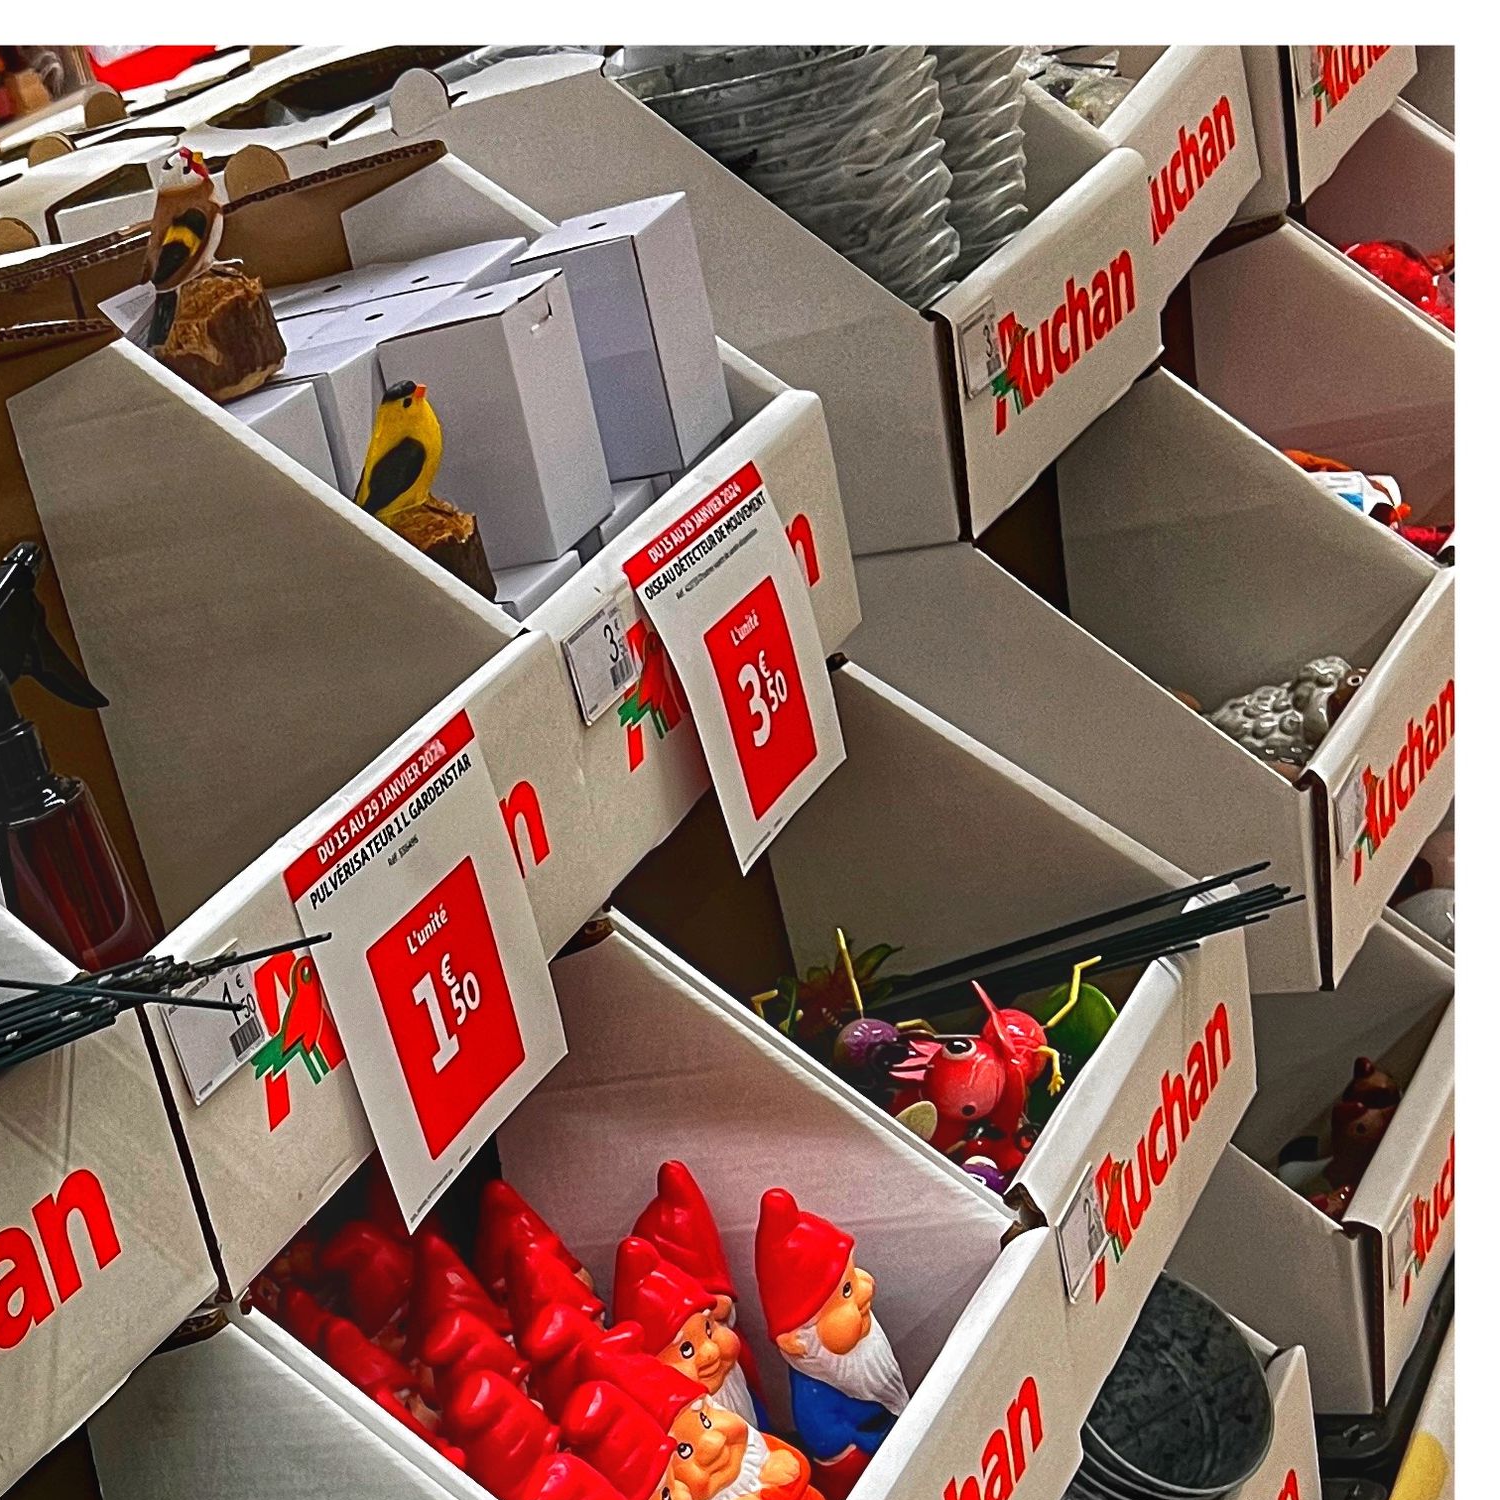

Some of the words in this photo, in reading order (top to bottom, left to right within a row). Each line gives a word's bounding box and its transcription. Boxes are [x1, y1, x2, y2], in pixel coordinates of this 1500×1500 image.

[1150, 95, 1237, 246] uchan
[994, 249, 1137, 435] Auchan
[644, 571, 676, 600] OISEAU
[674, 533, 718, 577] DÉTECTEUR
[713, 525, 728, 543] DE
[723, 490, 767, 535] MOUVEMENT
[690, 495, 725, 529] JANVIER
[729, 608, 760, 647] L'unité
[309, 823, 397, 910] PULVÉRISATEUR
[408, 752, 473, 820] GARDENSTAR
[316, 840, 334, 864] DU
[334, 829, 350, 852] 15
[349, 815, 366, 838] AU
[363, 798, 381, 823] 29
[379, 761, 423, 813] JANVIER
[406, 902, 449, 955] L'unité
[1094, 1002, 1232, 1305] Auchan
